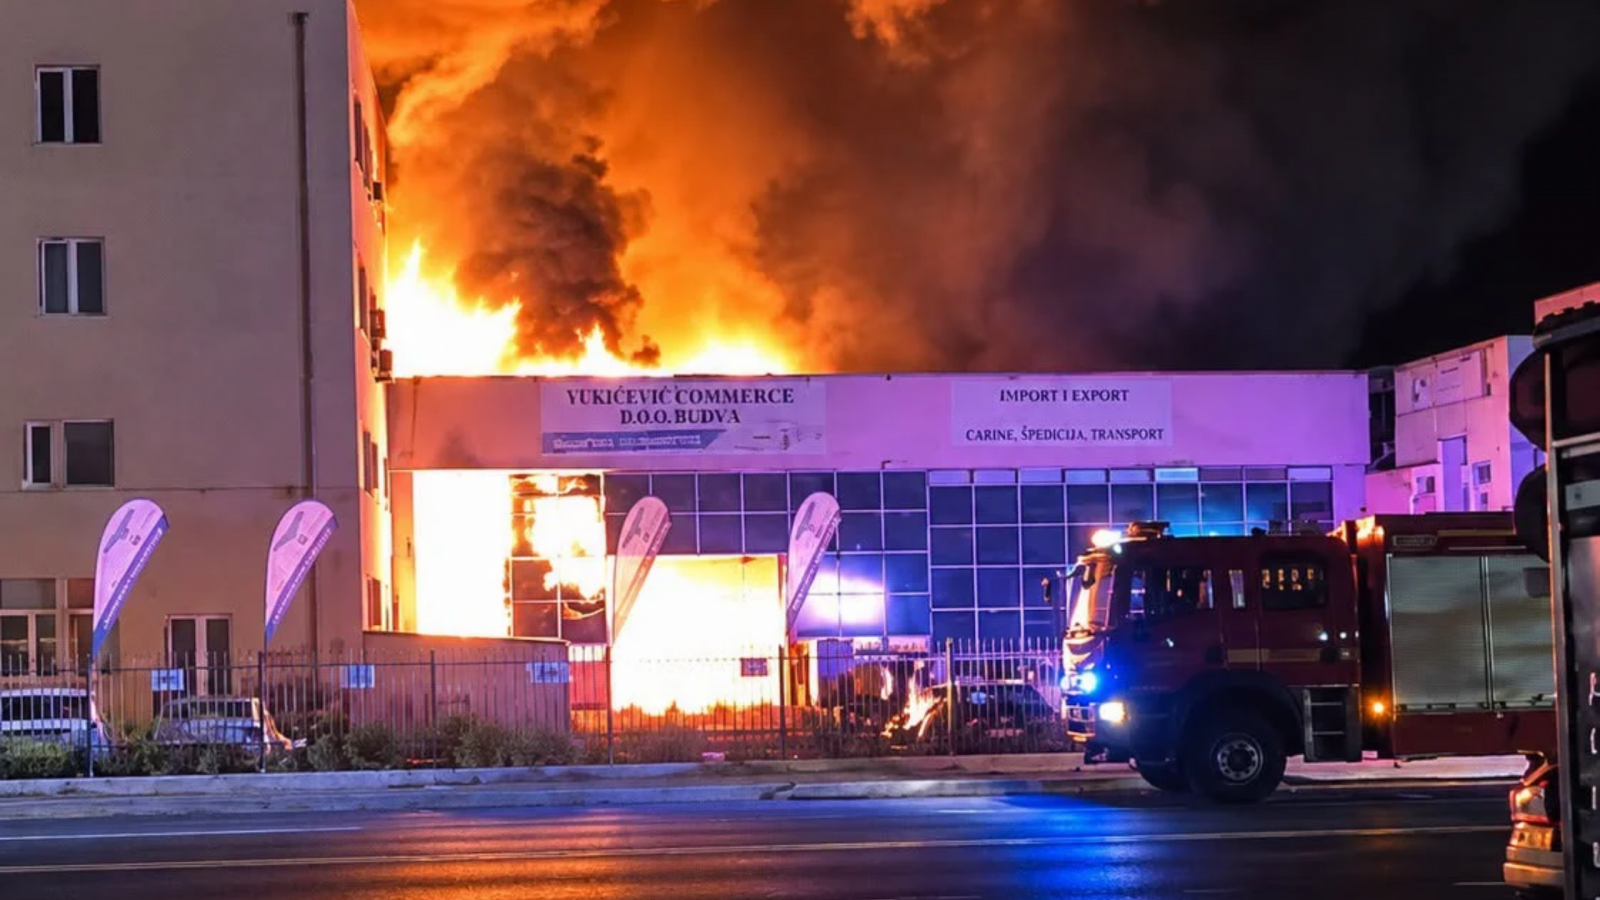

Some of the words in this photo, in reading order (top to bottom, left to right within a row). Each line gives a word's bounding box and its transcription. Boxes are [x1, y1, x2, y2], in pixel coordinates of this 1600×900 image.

[674, 388, 795, 405] COMMERCE
[1000, 389, 1058, 402] IMPORT
[1063, 389, 1068, 402] I
[1072, 389, 1129, 402] EXPORT
[620, 409, 672, 425] D.O.O.
[675, 408, 741, 424] BUDVA
[966, 429, 1017, 442] CARINE,
[1091, 428, 1164, 442] TRANSPORT
